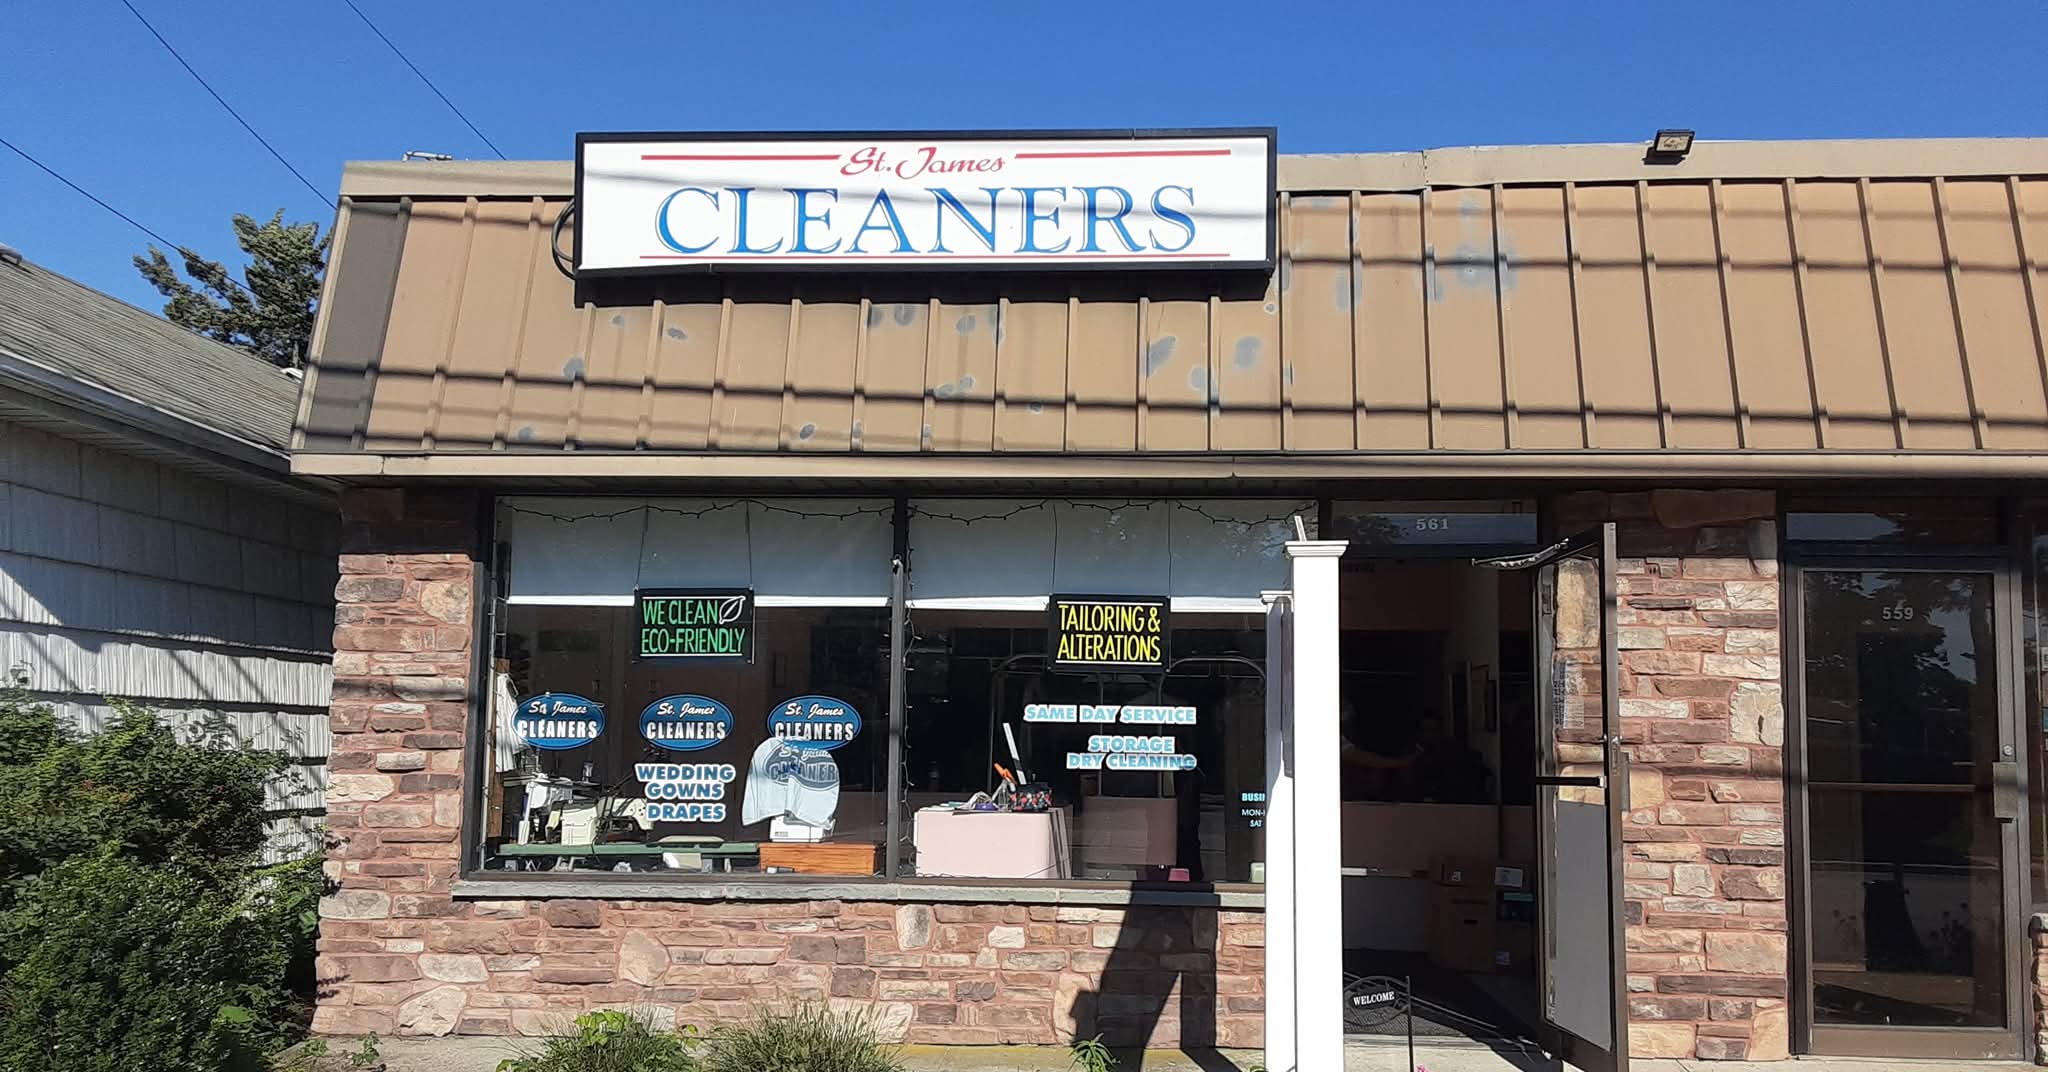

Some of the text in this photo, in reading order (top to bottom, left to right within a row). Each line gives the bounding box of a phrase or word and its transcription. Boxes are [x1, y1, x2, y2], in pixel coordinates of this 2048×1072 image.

[840, 147, 1005, 180] St. James
[655, 185, 1196, 254] CLEANERS
[1416, 518, 1448, 530] 561
[643, 600, 718, 625] WE CLEAN
[1058, 605, 1161, 632] TAILORING &
[1882, 606, 1913, 620] 559
[641, 628, 745, 653] ECO-FRIENDLY
[1057, 633, 1161, 661] ALTERATIONS
[551, 701, 588, 717] James
[679, 702, 715, 718] James
[807, 703, 844, 719] James
[1024, 704, 1197, 724] SAME DAY SERVICE
[517, 719, 598, 739] CLEANERS
[646, 721, 726, 740] CLEANERS
[775, 722, 854, 741] CLEANERS
[1088, 735, 1175, 754] STORAGE
[1066, 752, 1197, 771] DRY CLEANING
[635, 764, 736, 782] WEDDING
[645, 782, 725, 799] GOWNS
[646, 803, 726, 822] DRAPES
[1353, 991, 1395, 1006] WELCOME
